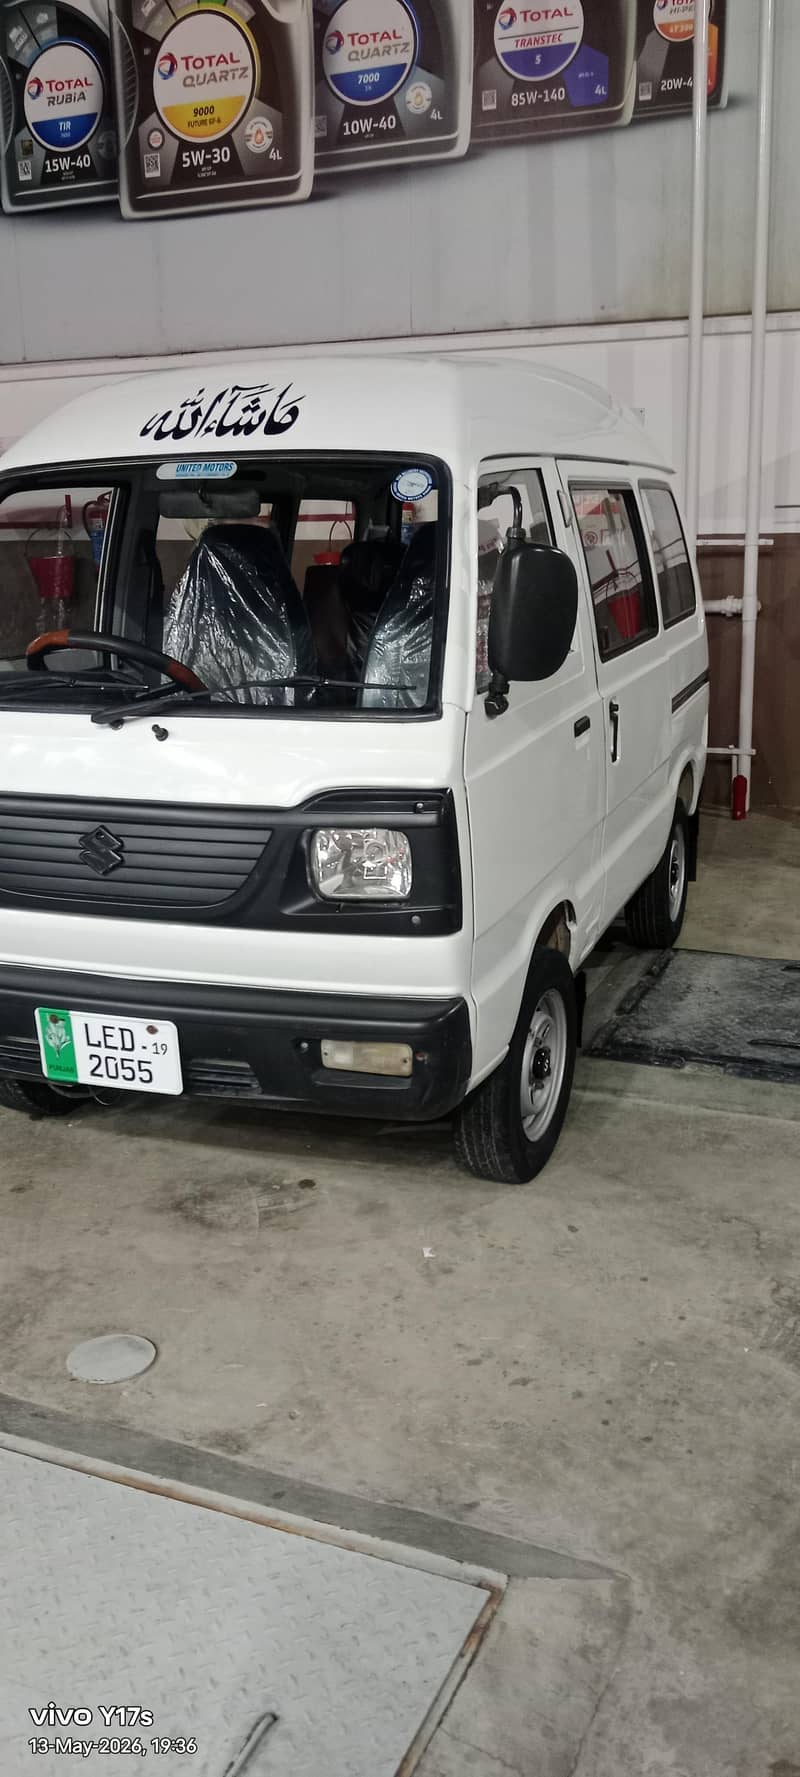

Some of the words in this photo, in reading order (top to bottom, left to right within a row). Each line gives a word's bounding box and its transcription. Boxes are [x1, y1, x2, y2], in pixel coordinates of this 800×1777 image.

[520, 5, 573, 22] TOTAL
[347, 30, 402, 46] TOTAL
[514, 33, 563, 48] TRANSTEC
[347, 41, 410, 62] QUARTZ
[534, 54, 542, 65] 5
[181, 52, 241, 71] TOTAL
[46, 76, 94, 92] TOTAL
[182, 66, 249, 88] QUARTZ
[358, 72, 380, 85] 7000
[660, 77, 696, 92] 20W-4
[511, 87, 566, 106] 85W-140
[594, 84, 607, 96] 4L
[193, 105, 215, 117] 9000
[430, 108, 443, 121] 4L
[58, 121, 71, 132] TIR
[343, 115, 396, 136] 10W-40
[182, 146, 231, 168] 5W-30
[269, 148, 283, 161] 4L
[45, 154, 91, 173] 15W-40
[176, 463, 202, 473] UNITED
[203, 462, 234, 472] MOTORS
[84, 1023, 135, 1052] LED
[89, 1054, 154, 1084] 2055
